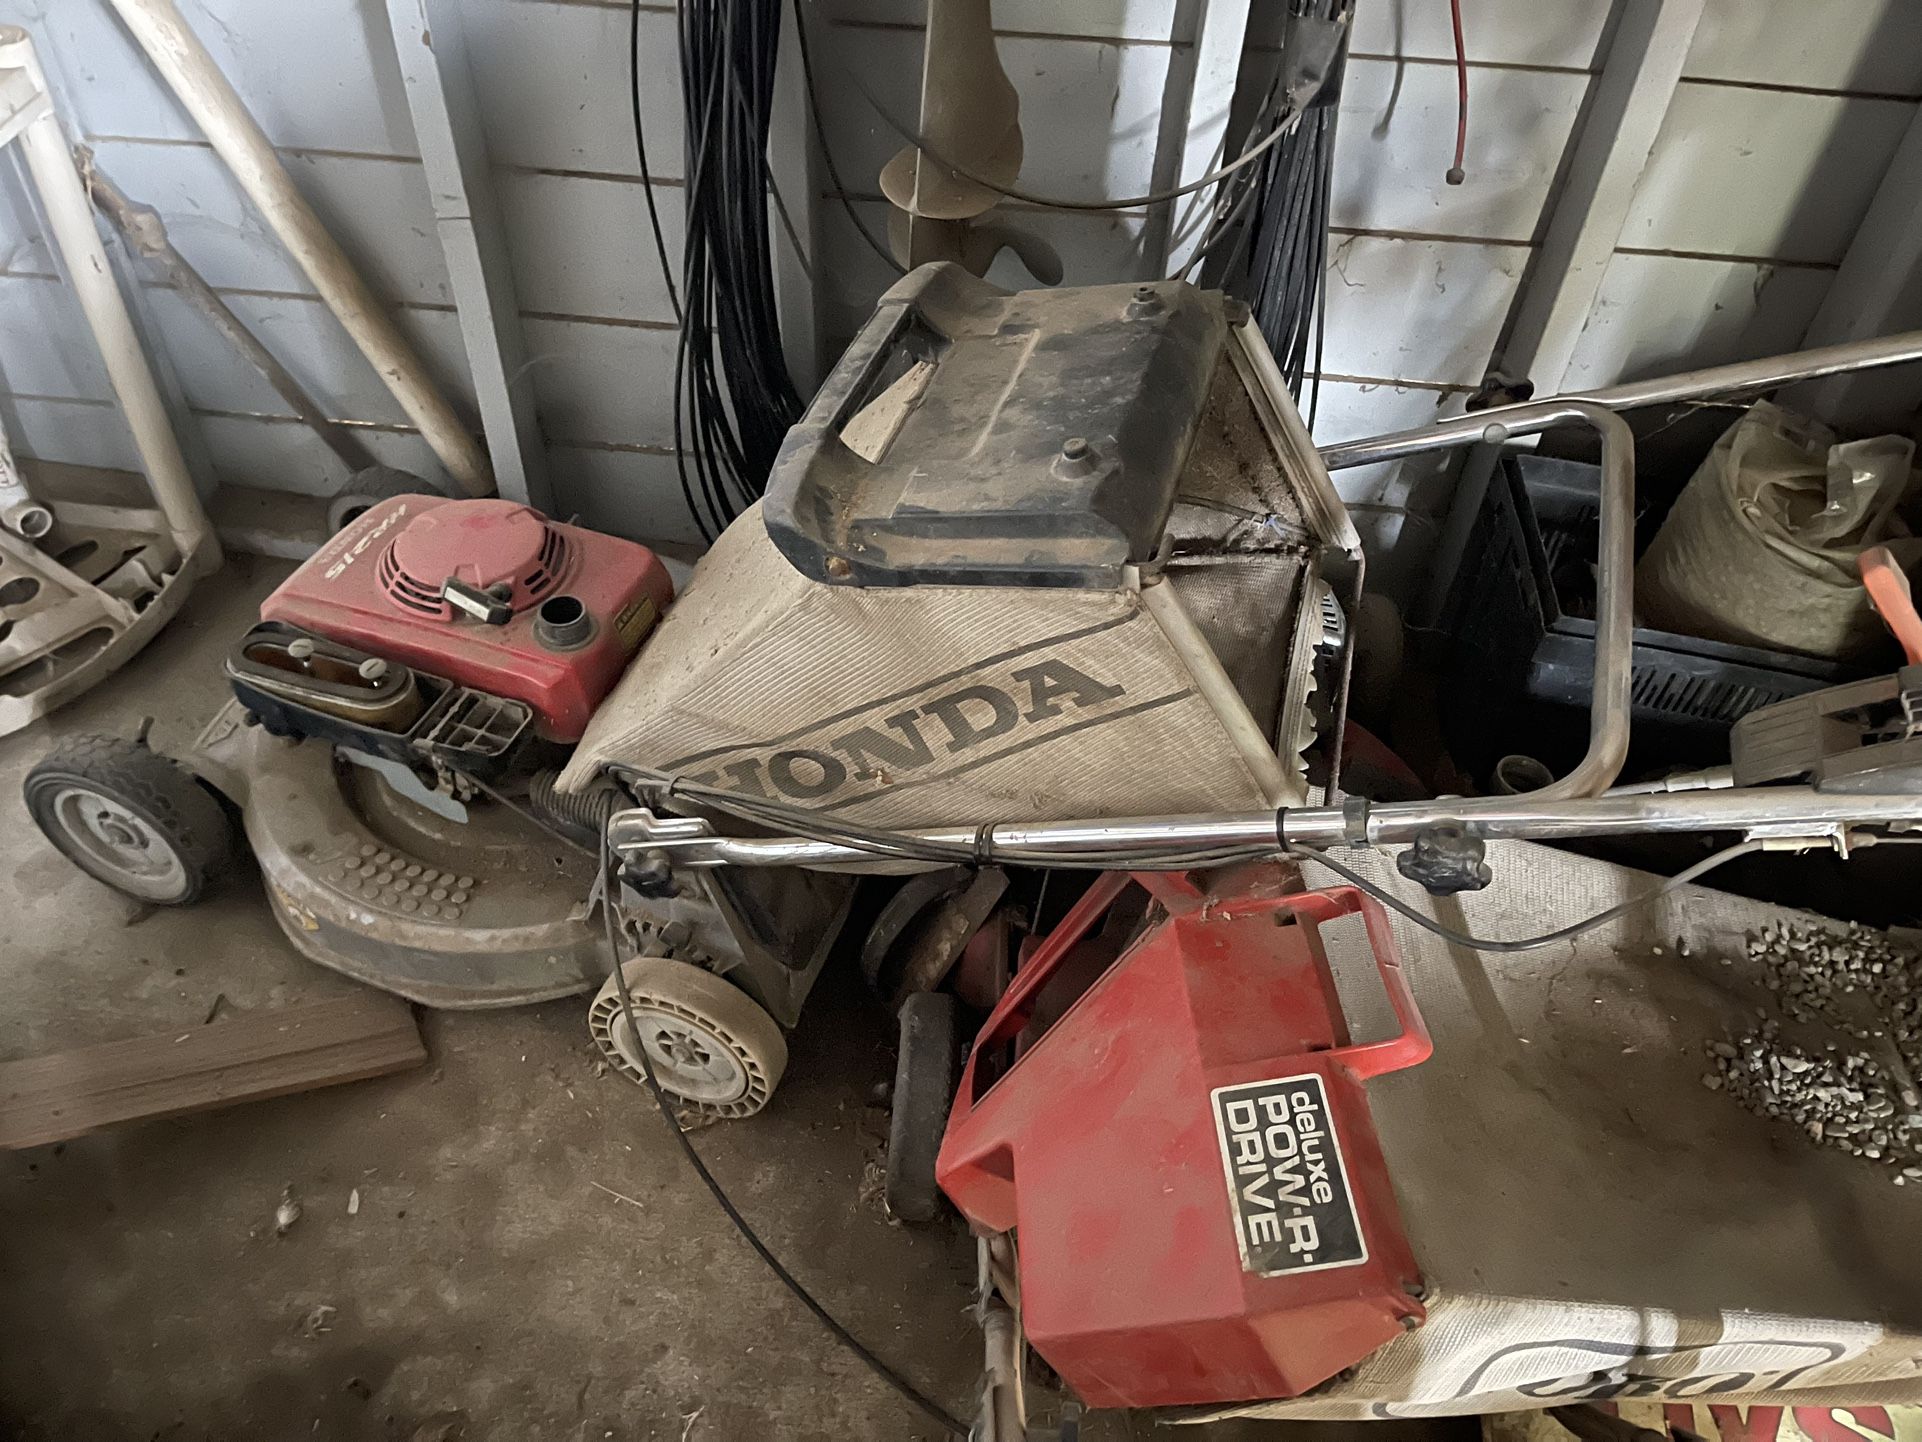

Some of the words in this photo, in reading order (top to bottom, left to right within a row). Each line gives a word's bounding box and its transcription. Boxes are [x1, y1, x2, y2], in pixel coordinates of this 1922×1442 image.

[690, 658, 1126, 801] HONDA
[1226, 1099, 1282, 1246] DRIVE
[1291, 1091, 1333, 1204] deluxe
